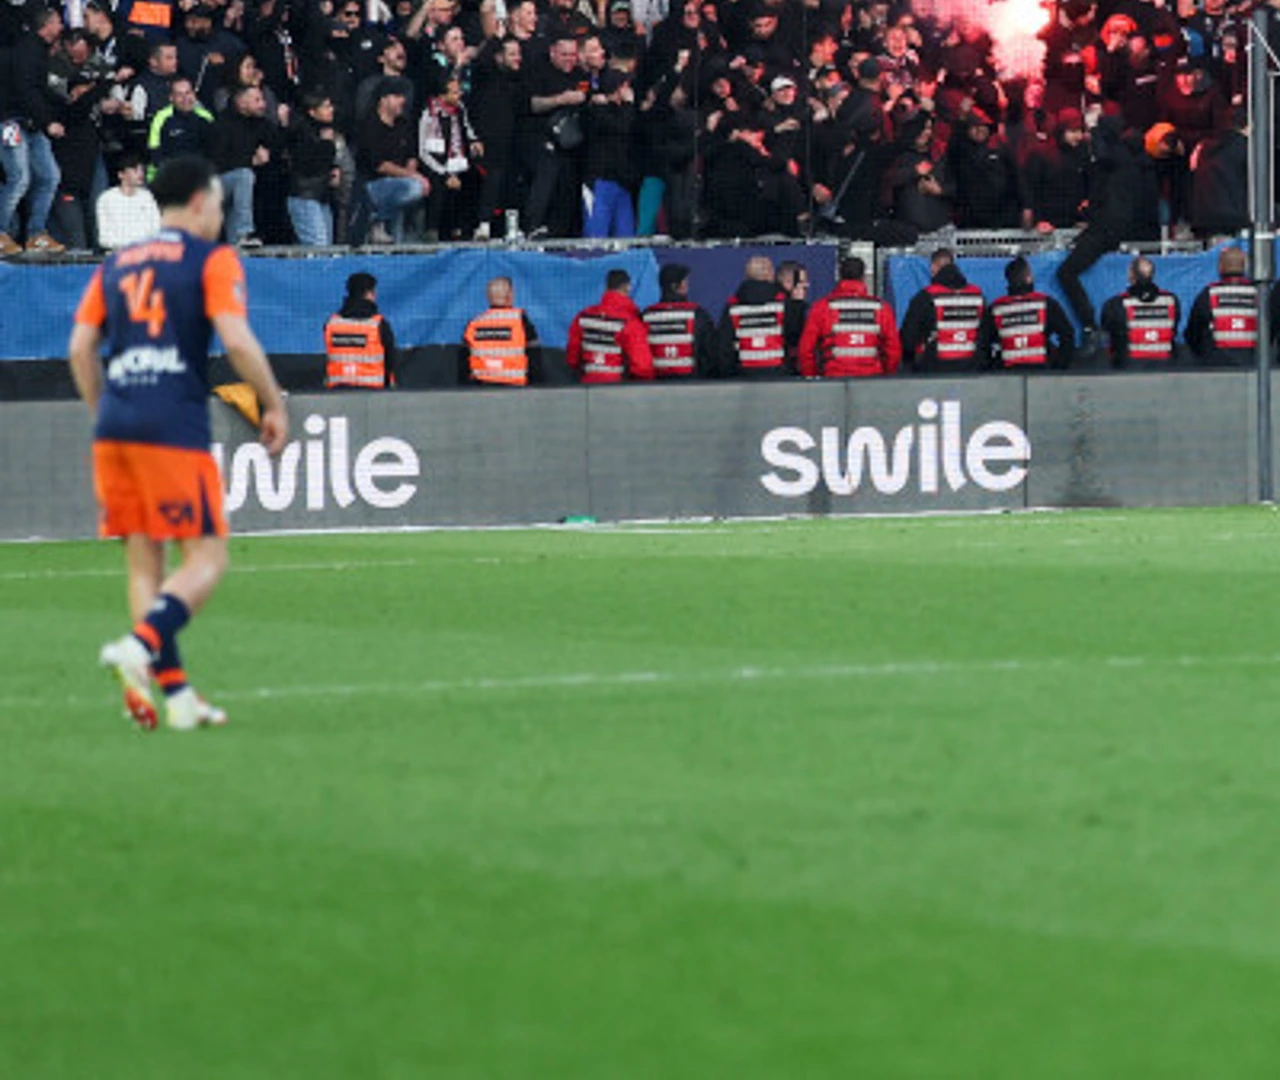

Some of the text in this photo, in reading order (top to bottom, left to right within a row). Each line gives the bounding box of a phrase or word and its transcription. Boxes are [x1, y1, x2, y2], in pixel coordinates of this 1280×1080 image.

[119, 268, 167, 338] 14
[211, 413, 420, 511] wile
[760, 398, 1031, 497] swile
